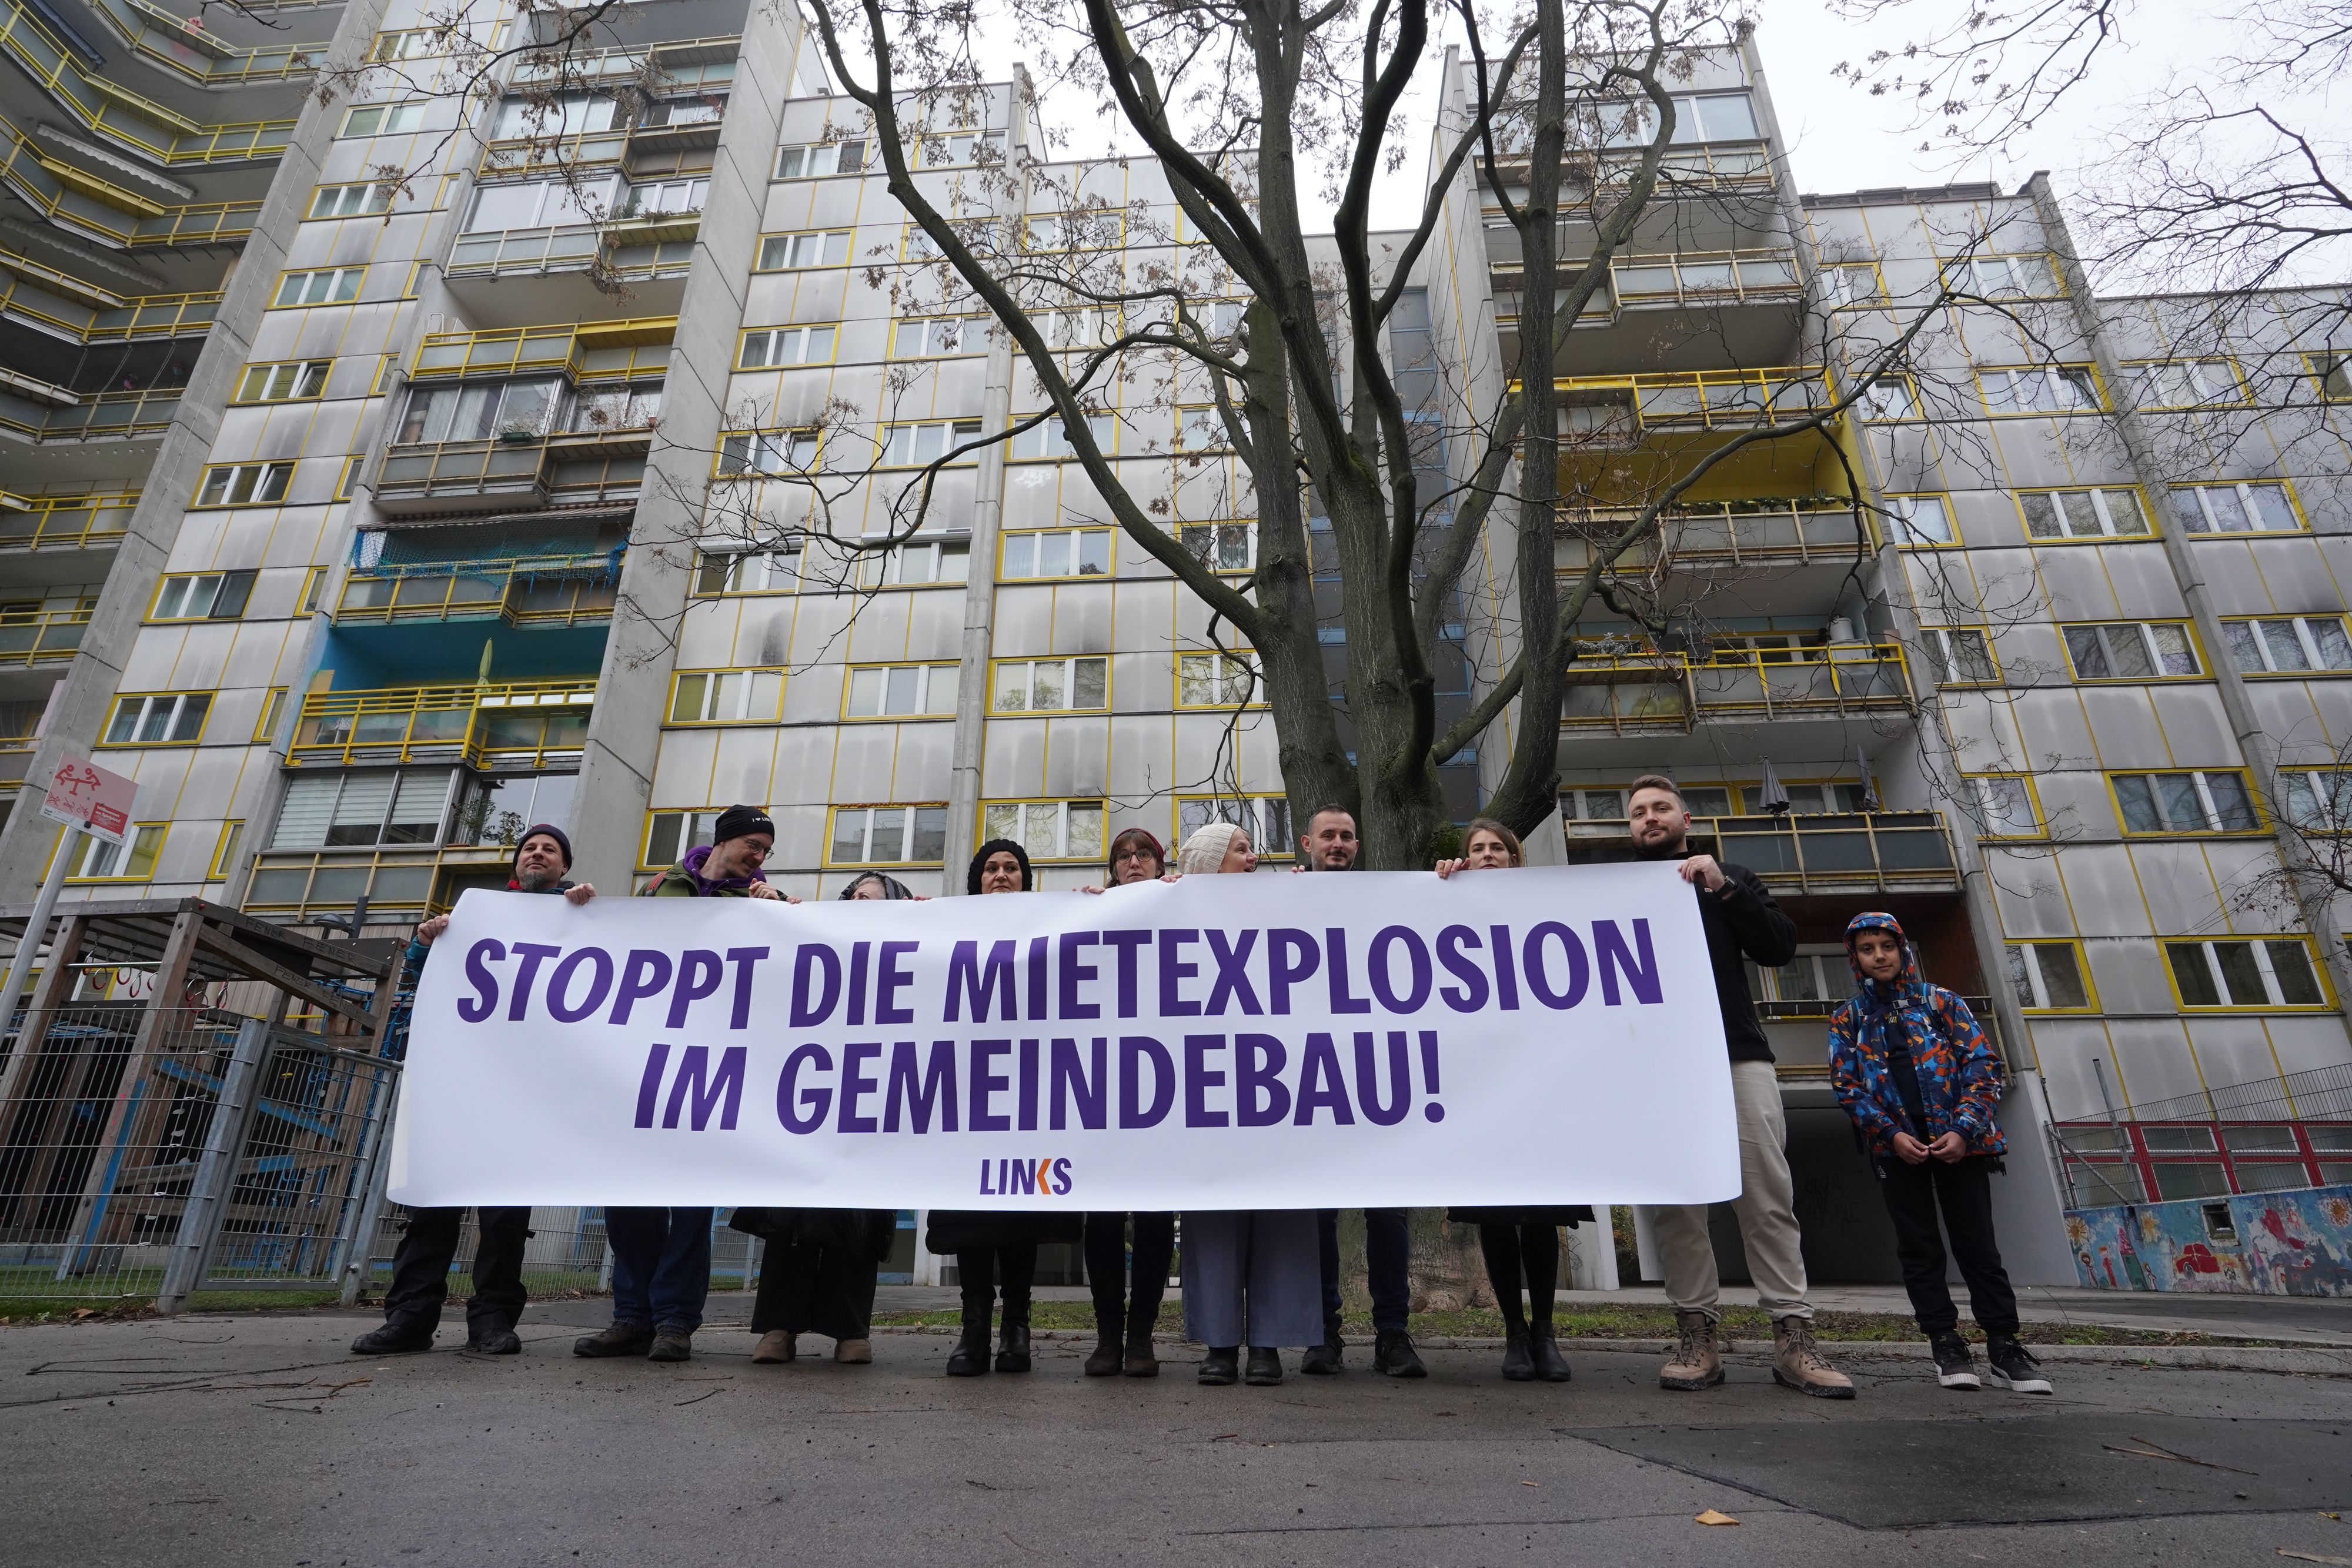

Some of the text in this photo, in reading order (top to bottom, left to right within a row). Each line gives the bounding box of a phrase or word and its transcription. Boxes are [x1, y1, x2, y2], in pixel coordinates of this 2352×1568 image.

[245, 916, 286, 939] FENER
[302, 937, 356, 966] FENER
[457, 918, 1663, 1029] STOPPT DIE MIETEXPLOSION
[634, 1031, 1445, 1135] IM GEMEINDEBAU!
[980, 1158, 1072, 1195] LINKS
